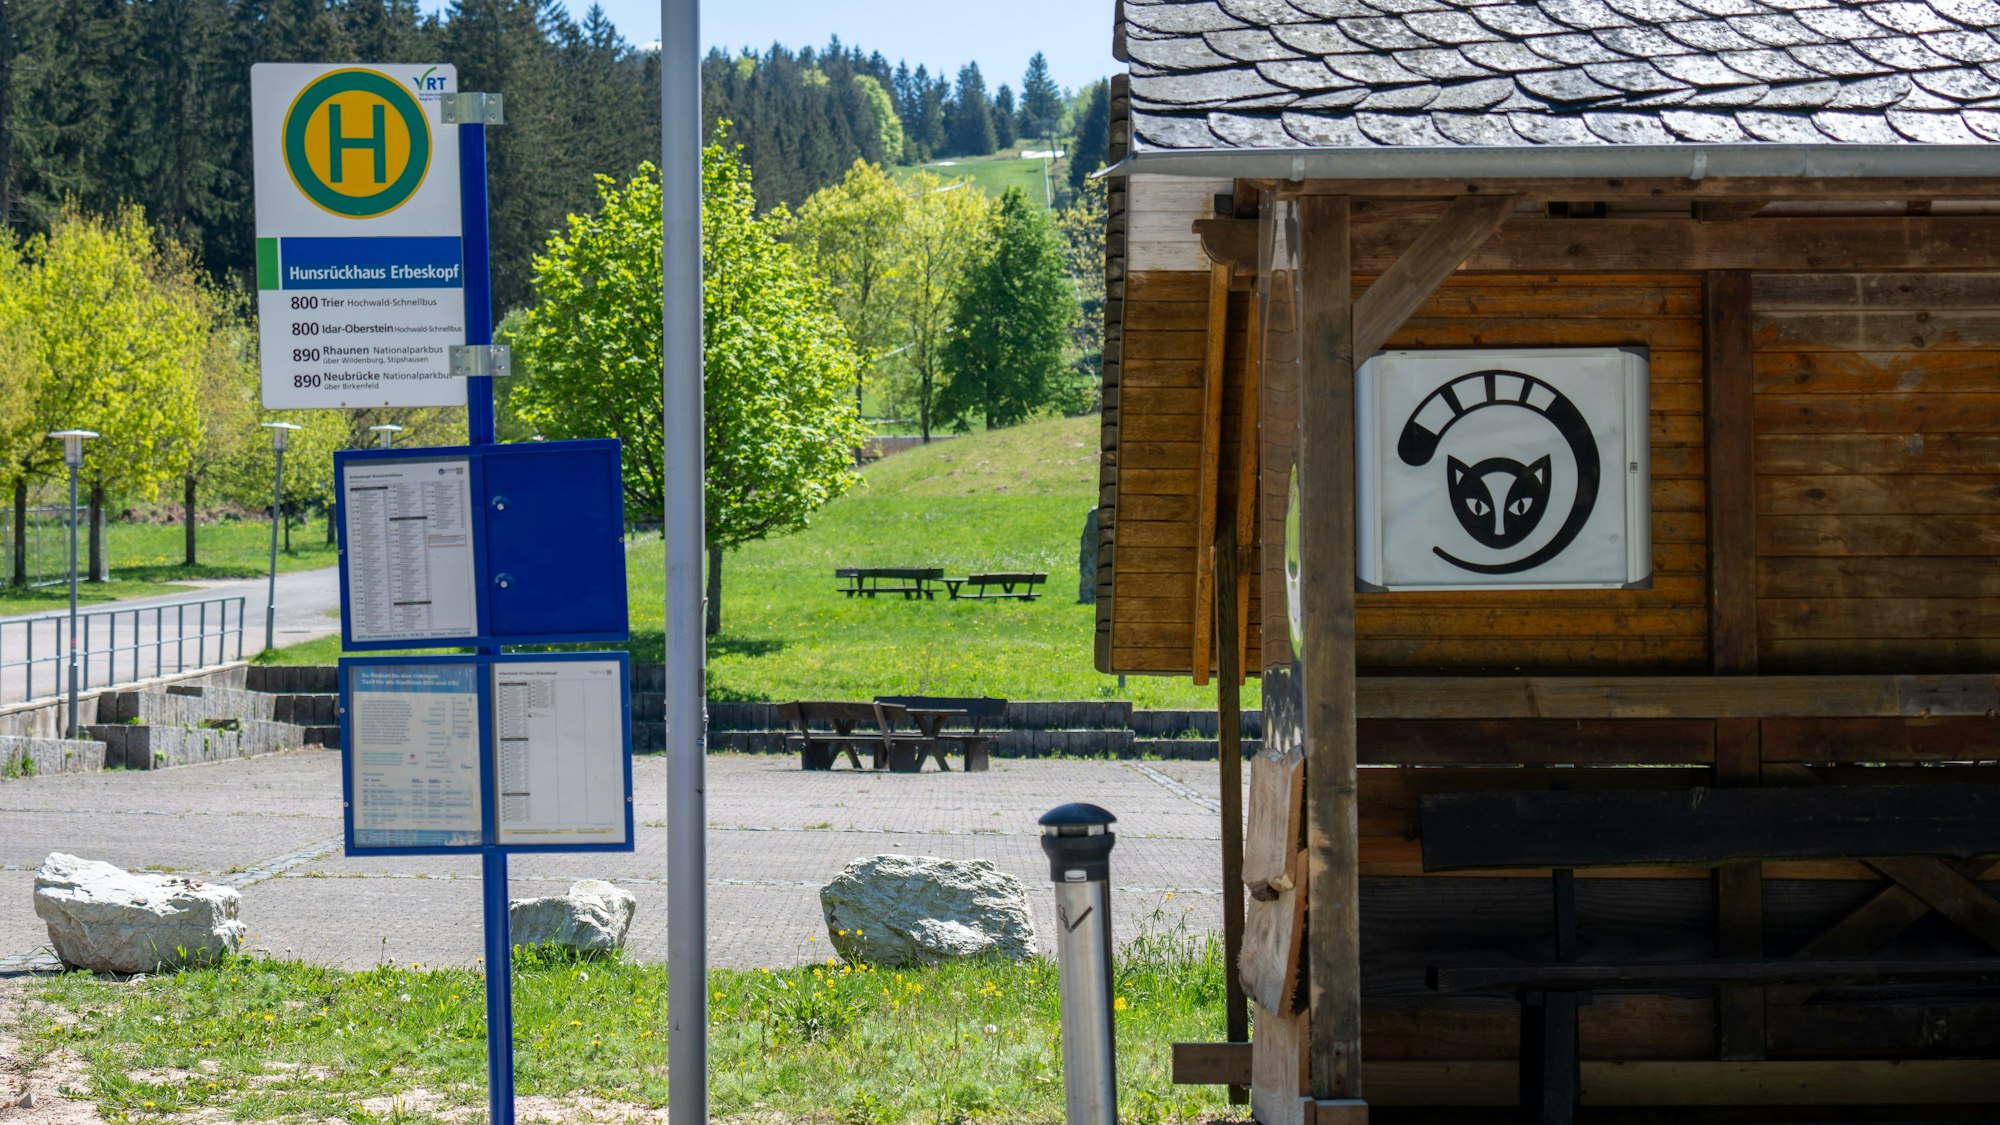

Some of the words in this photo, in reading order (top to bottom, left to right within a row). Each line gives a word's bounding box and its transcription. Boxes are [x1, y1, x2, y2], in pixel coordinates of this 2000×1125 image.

[412, 66, 447, 90] VRT
[328, 104, 387, 184] H
[289, 264, 387, 280] Hunsrückhaus
[390, 264, 459, 282] Erbeskopf
[291, 296, 318, 310] 800
[321, 298, 345, 307] Trier
[347, 298, 438, 307] Hochwald-Schnellbus
[292, 322, 319, 336] 800
[322, 323, 394, 334] Idar-Oberstein
[394, 325, 463, 333] Hochwald-Schnellbus
[292, 348, 320, 362] 890
[323, 346, 370, 355] Rhaunen
[373, 345, 444, 355] Nationalparkbus
[342, 356, 386, 365] Wildenburg,
[387, 356, 429, 364] Stipshausen
[293, 374, 321, 388] 890
[323, 371, 380, 381] Neubrücke
[342, 382, 379, 390] Birkenfeld
